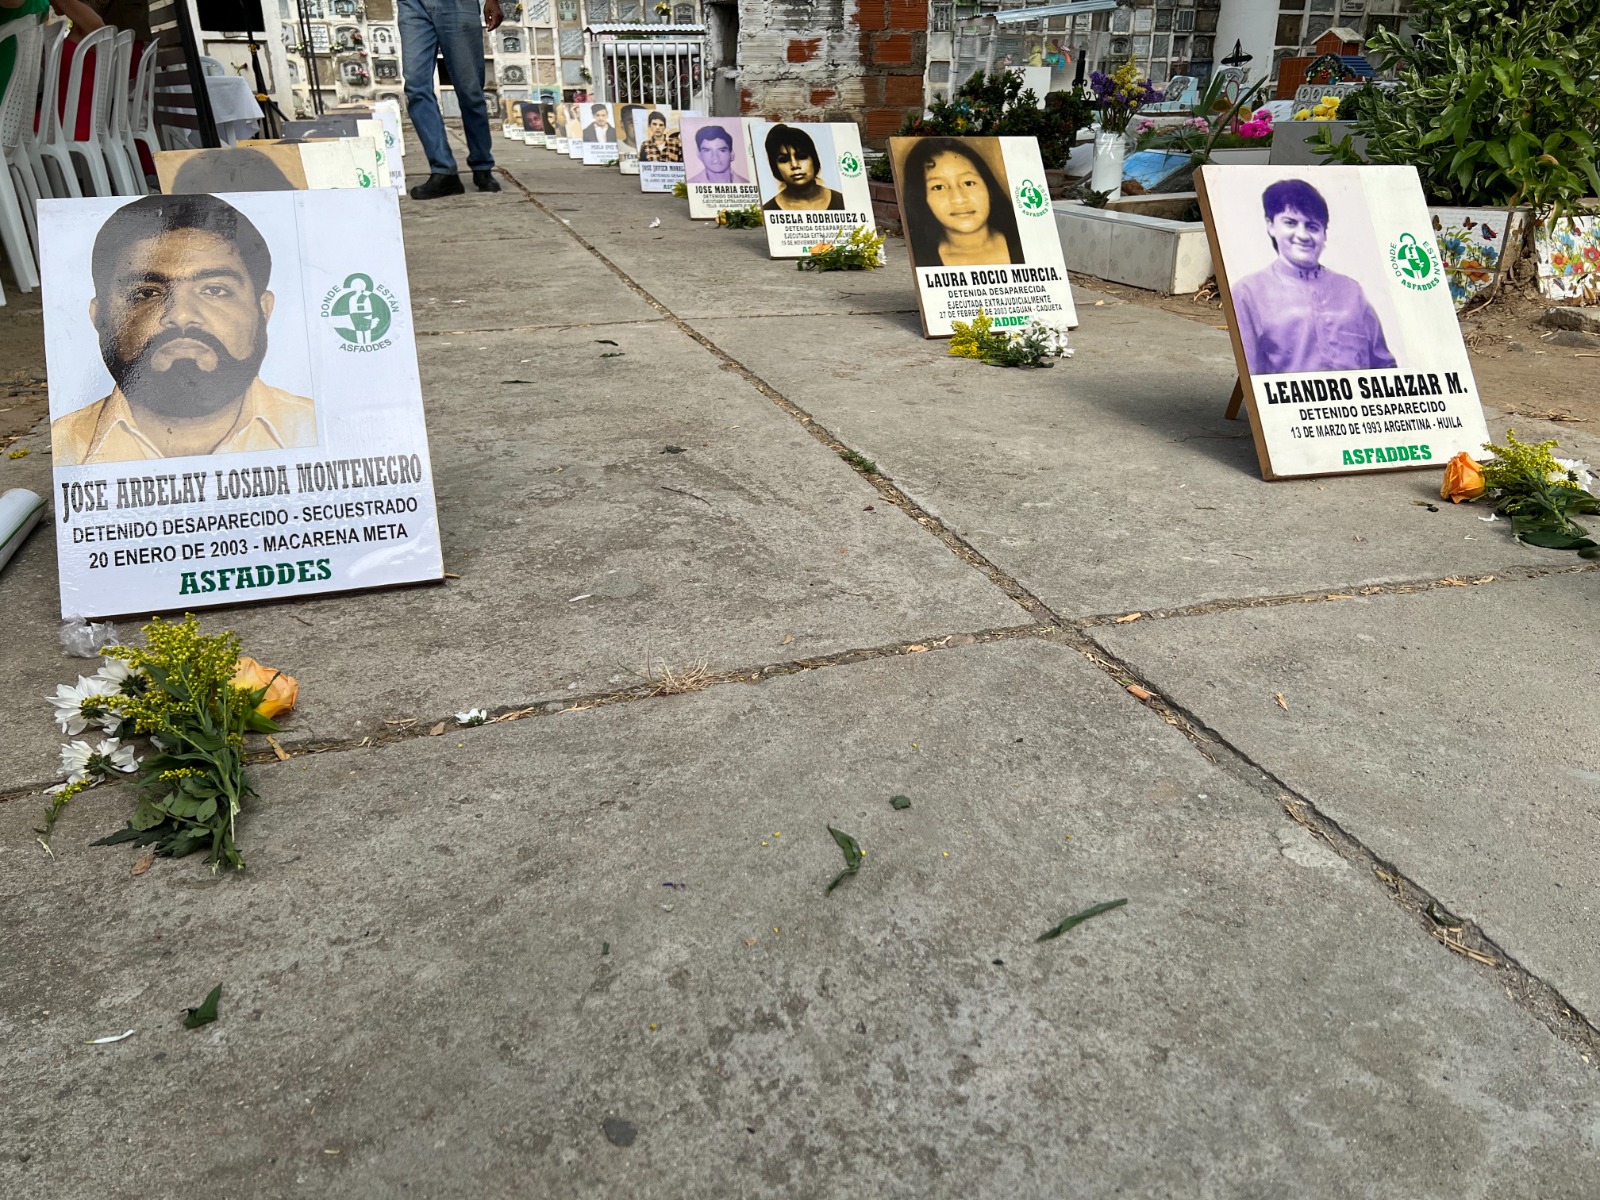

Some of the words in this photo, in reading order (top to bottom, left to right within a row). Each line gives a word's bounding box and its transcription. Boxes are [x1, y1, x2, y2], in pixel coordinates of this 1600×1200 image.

[696, 185, 713, 193] JOSE
[714, 185, 738, 193] MARIA
[740, 185, 758, 193] SEGU
[770, 214, 804, 224] GISELA
[806, 213, 858, 224] RODRIGUEZ
[860, 212, 869, 223] O.
[1390, 242, 1402, 277] DONDE
[1422, 240, 1440, 276] ESTAN
[926, 272, 968, 288] LAURA
[970, 270, 1008, 286] ROCIO
[1012, 267, 1062, 283] MURCIA.
[1401, 277, 1440, 290] ASFADDES
[320, 284, 341, 318] DONDE
[947, 300, 984, 310] EJECUTADA
[984, 295, 1052, 308] EXTRAJUDICIALMENTE
[948, 288, 988, 298] DETENIDA
[988, 285, 1046, 296] DESAPARECIDA
[948, 310, 956, 318] DE
[957, 308, 980, 318] FEBRER
[985, 308, 993, 316] DE
[994, 307, 1008, 316] 2003
[1009, 305, 1032, 314] CAGUAN
[1036, 304, 1062, 312] CAQUETA
[339, 338, 392, 352] ASFADDES
[1264, 377, 1353, 405] LEANDRO
[1358, 374, 1442, 400] SALAZAR
[1444, 372, 1468, 395] M.
[1299, 403, 1358, 421] DETENIDO
[1361, 400, 1446, 416] DESAPARECIDO
[1290, 427, 1302, 439] 13
[1303, 426, 1315, 438] DE
[1316, 423, 1348, 438] MARZO
[1349, 422, 1361, 436] DE
[1362, 421, 1382, 434] 1993
[1384, 418, 1432, 433] ARGENTINA
[1438, 416, 1463, 429] HUILA
[1342, 444, 1432, 466] ASFADDES
[62, 480, 109, 524] JOSE
[116, 471, 207, 509] ARBELAY
[214, 465, 290, 500] LOSADA
[296, 453, 422, 494] MONTENEGRO
[73, 520, 158, 544] DETENIDO
[162, 509, 289, 536] DESAPARECIDO
[302, 496, 418, 522] SECUESTRADO
[89, 552, 109, 569] 20
[114, 546, 176, 566] ENERO
[182, 542, 206, 560] DE
[210, 538, 248, 558] 2003
[263, 528, 360, 552] MACARENA
[363, 523, 408, 542] META
[178, 558, 332, 595] ASFADDES
